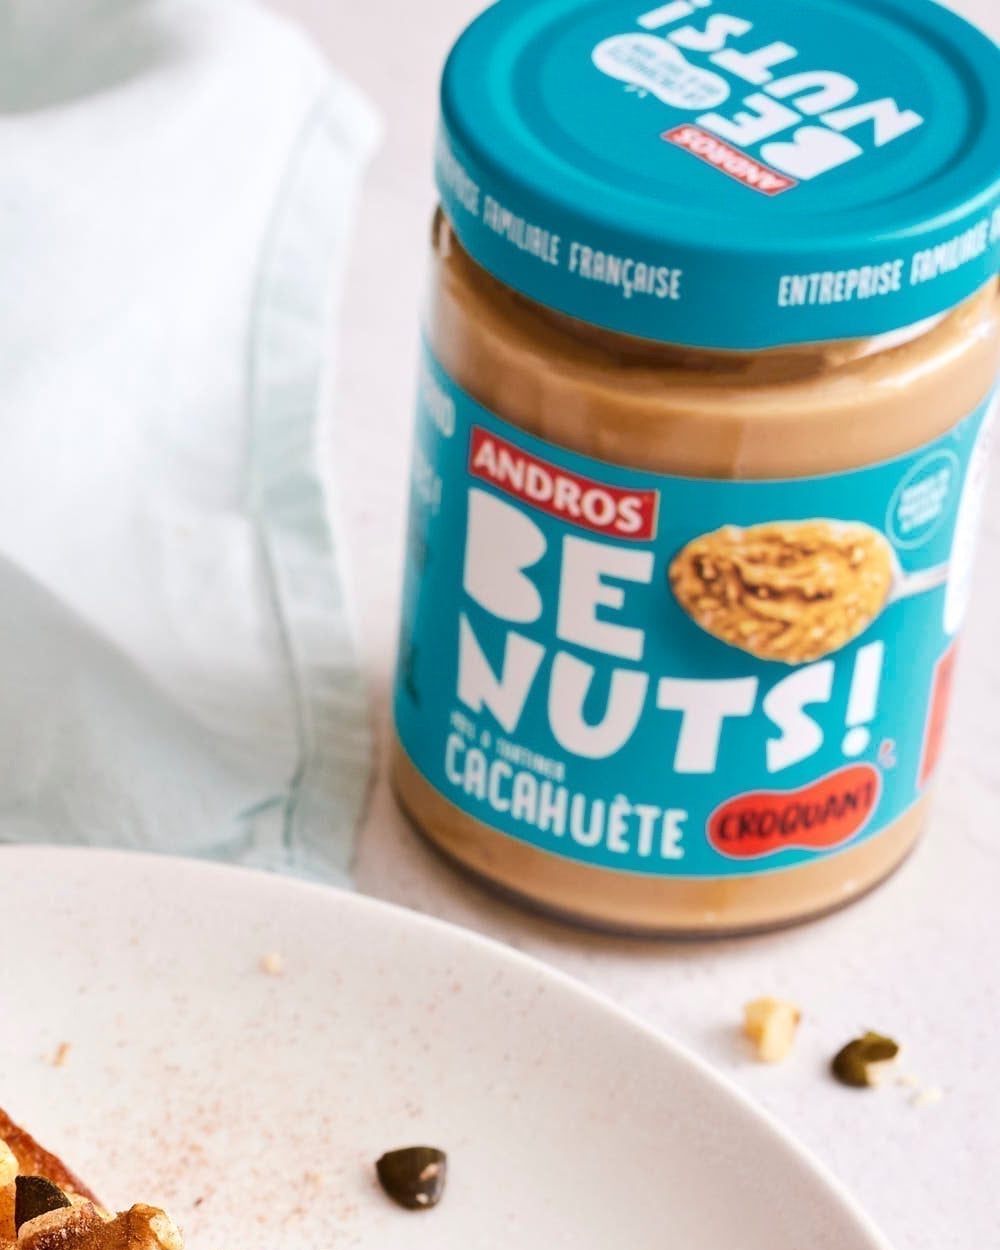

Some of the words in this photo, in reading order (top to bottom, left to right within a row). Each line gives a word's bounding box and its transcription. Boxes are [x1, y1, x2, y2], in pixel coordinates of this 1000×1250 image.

[636, 0, 924, 147] NUTS!
[671, 126, 786, 191] ANDROS
[695, 92, 864, 181] BE
[567, 241, 684, 301] FRANÇAISE
[777, 258, 905, 307] ENTREPRISE
[472, 439, 644, 534] ANDROS
[462, 486, 656, 662] BE
[456, 610, 885, 774] NUTS!
[717, 781, 873, 841] CROQUANT
